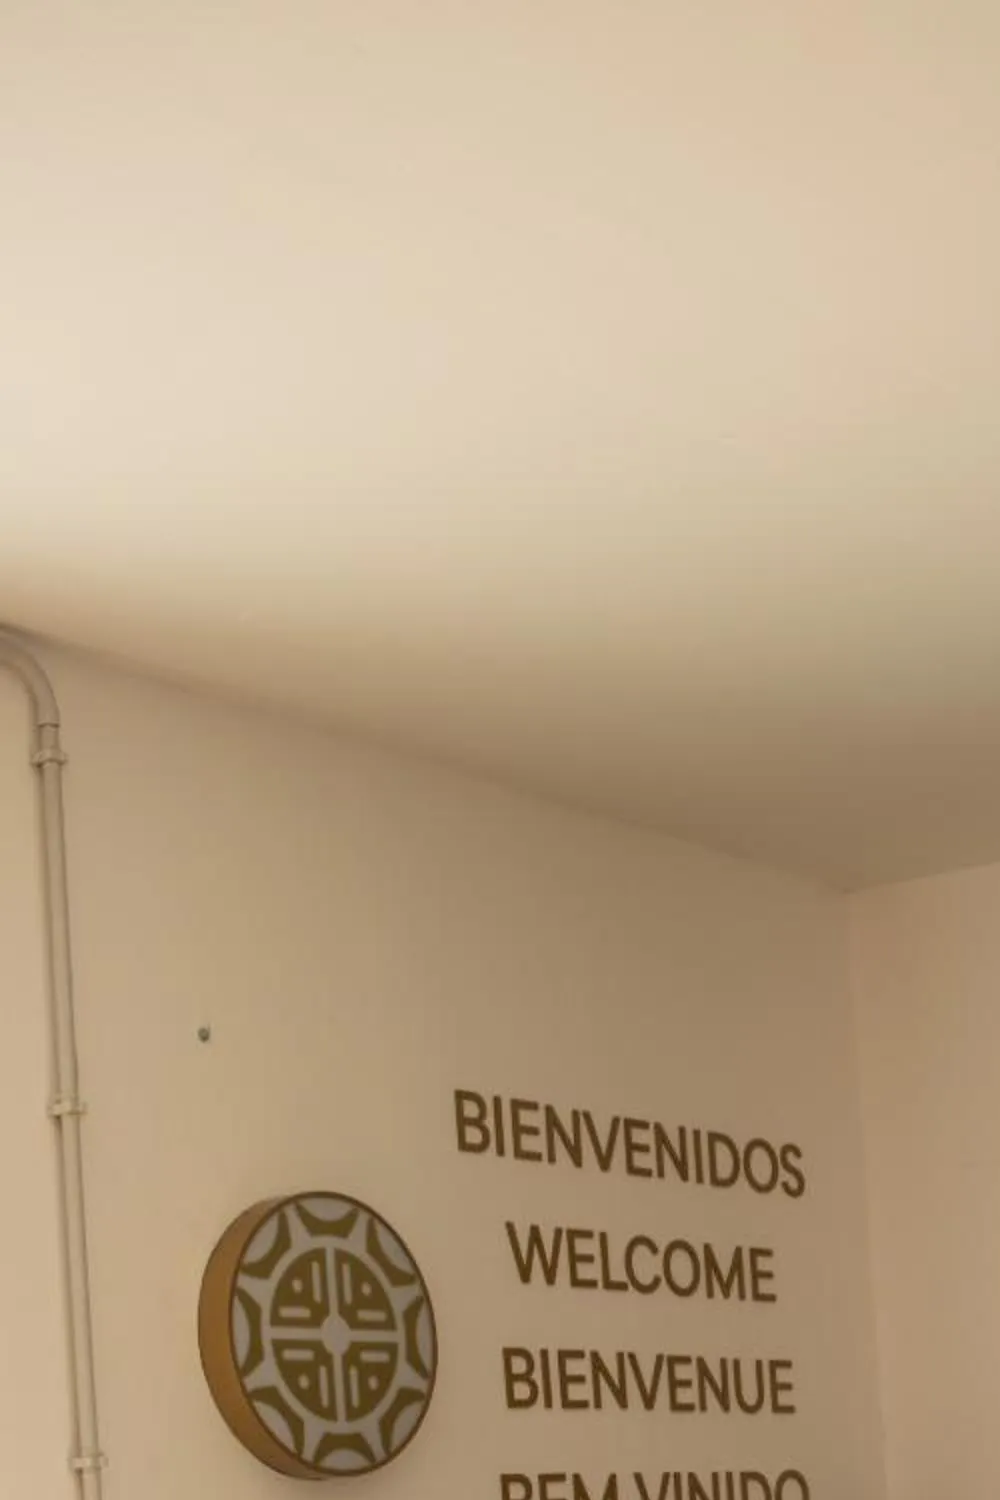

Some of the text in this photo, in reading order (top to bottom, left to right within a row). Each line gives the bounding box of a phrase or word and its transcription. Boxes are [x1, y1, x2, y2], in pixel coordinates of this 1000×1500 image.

[454, 1090, 805, 1199] BIENVENIDOS
[505, 1221, 777, 1303] WELCOME
[502, 1347, 796, 1415] BIENVENUE
